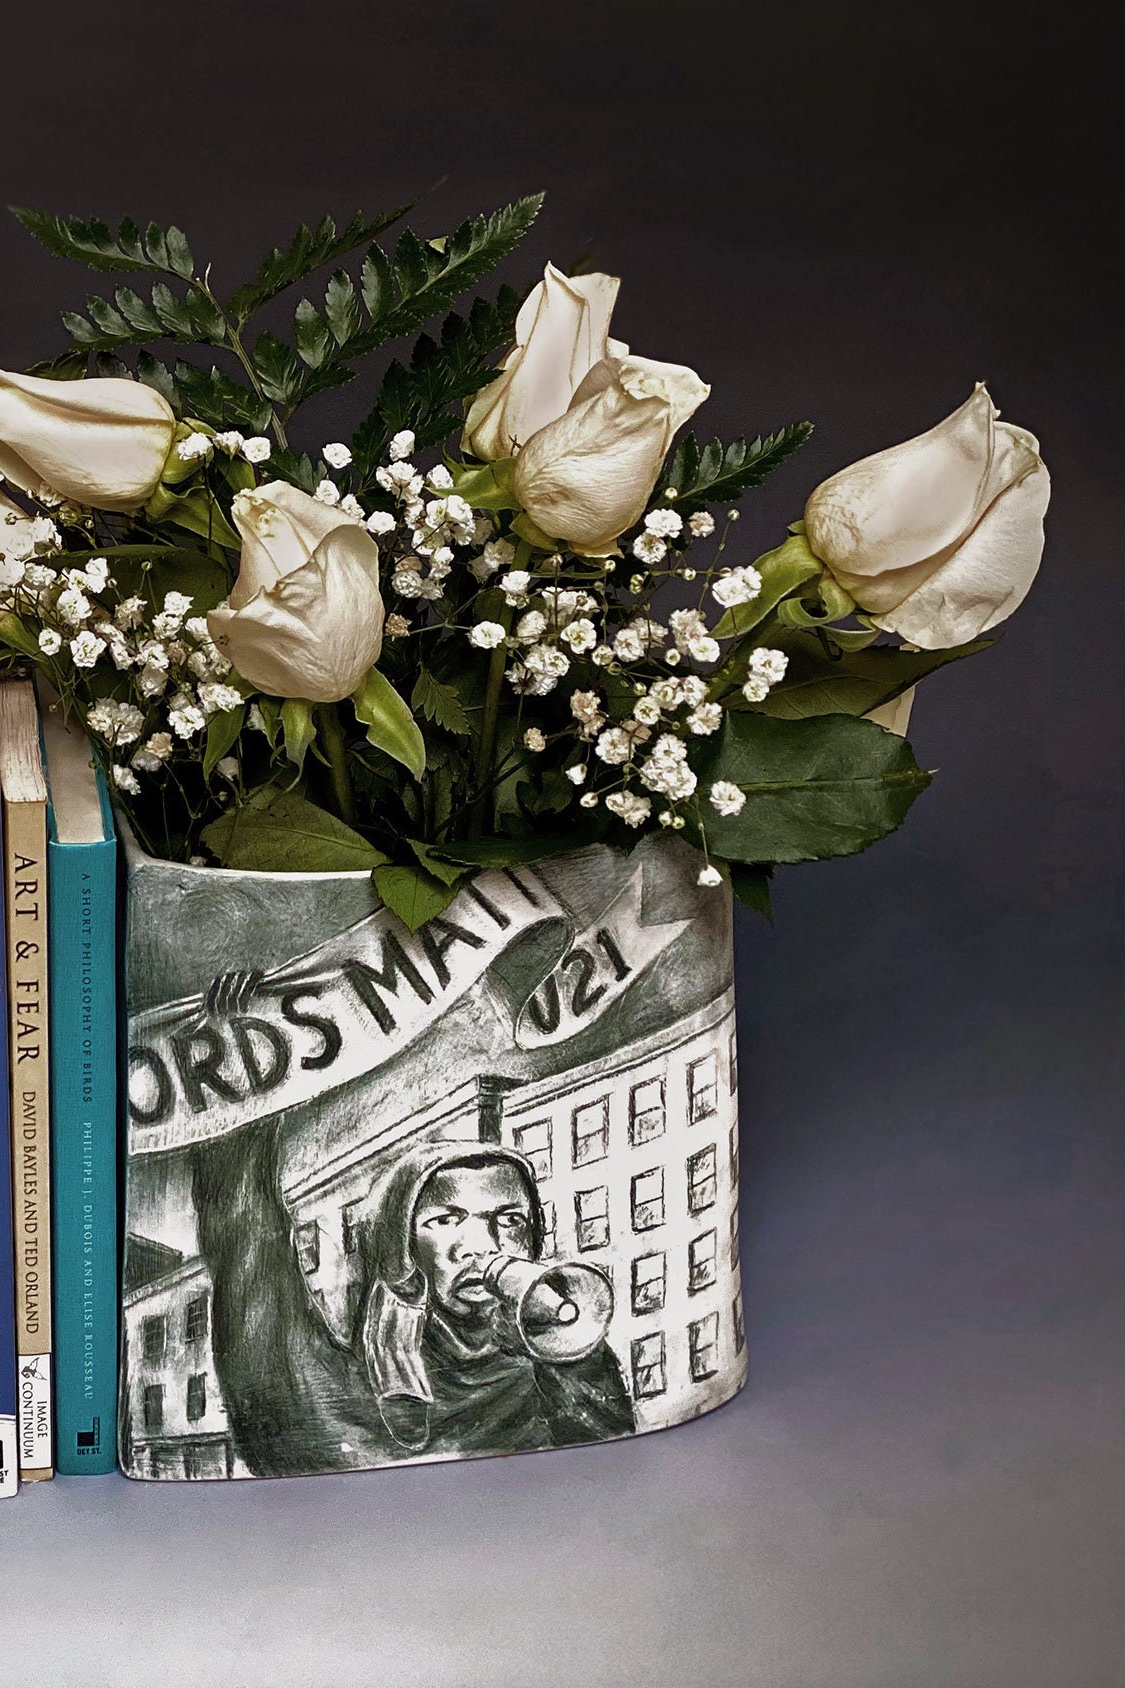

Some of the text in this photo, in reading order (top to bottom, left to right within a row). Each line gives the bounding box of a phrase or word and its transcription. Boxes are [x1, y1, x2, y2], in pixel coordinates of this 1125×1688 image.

[14, 852, 40, 1064] ART & FEAR
[341, 867, 539, 1034] MA
[81, 873, 92, 1103] A SHORT PHILOSOPHY OF BIRDS
[83, 1122, 93, 1184] PHILIPPE
[22, 1091, 39, 1335] DAVID BAYLES AND TED ORLAND
[83, 1205, 93, 1254] DUBOIS
[84, 1259, 93, 1287] AND
[83, 1292, 93, 1328] ELISE
[84, 1334, 93, 1399] ROUSSEAU
[22, 1381, 34, 1459] CONTINUUM
[37, 1400, 48, 1439] IMAGE
[76, 1448, 90, 1456] DEY
